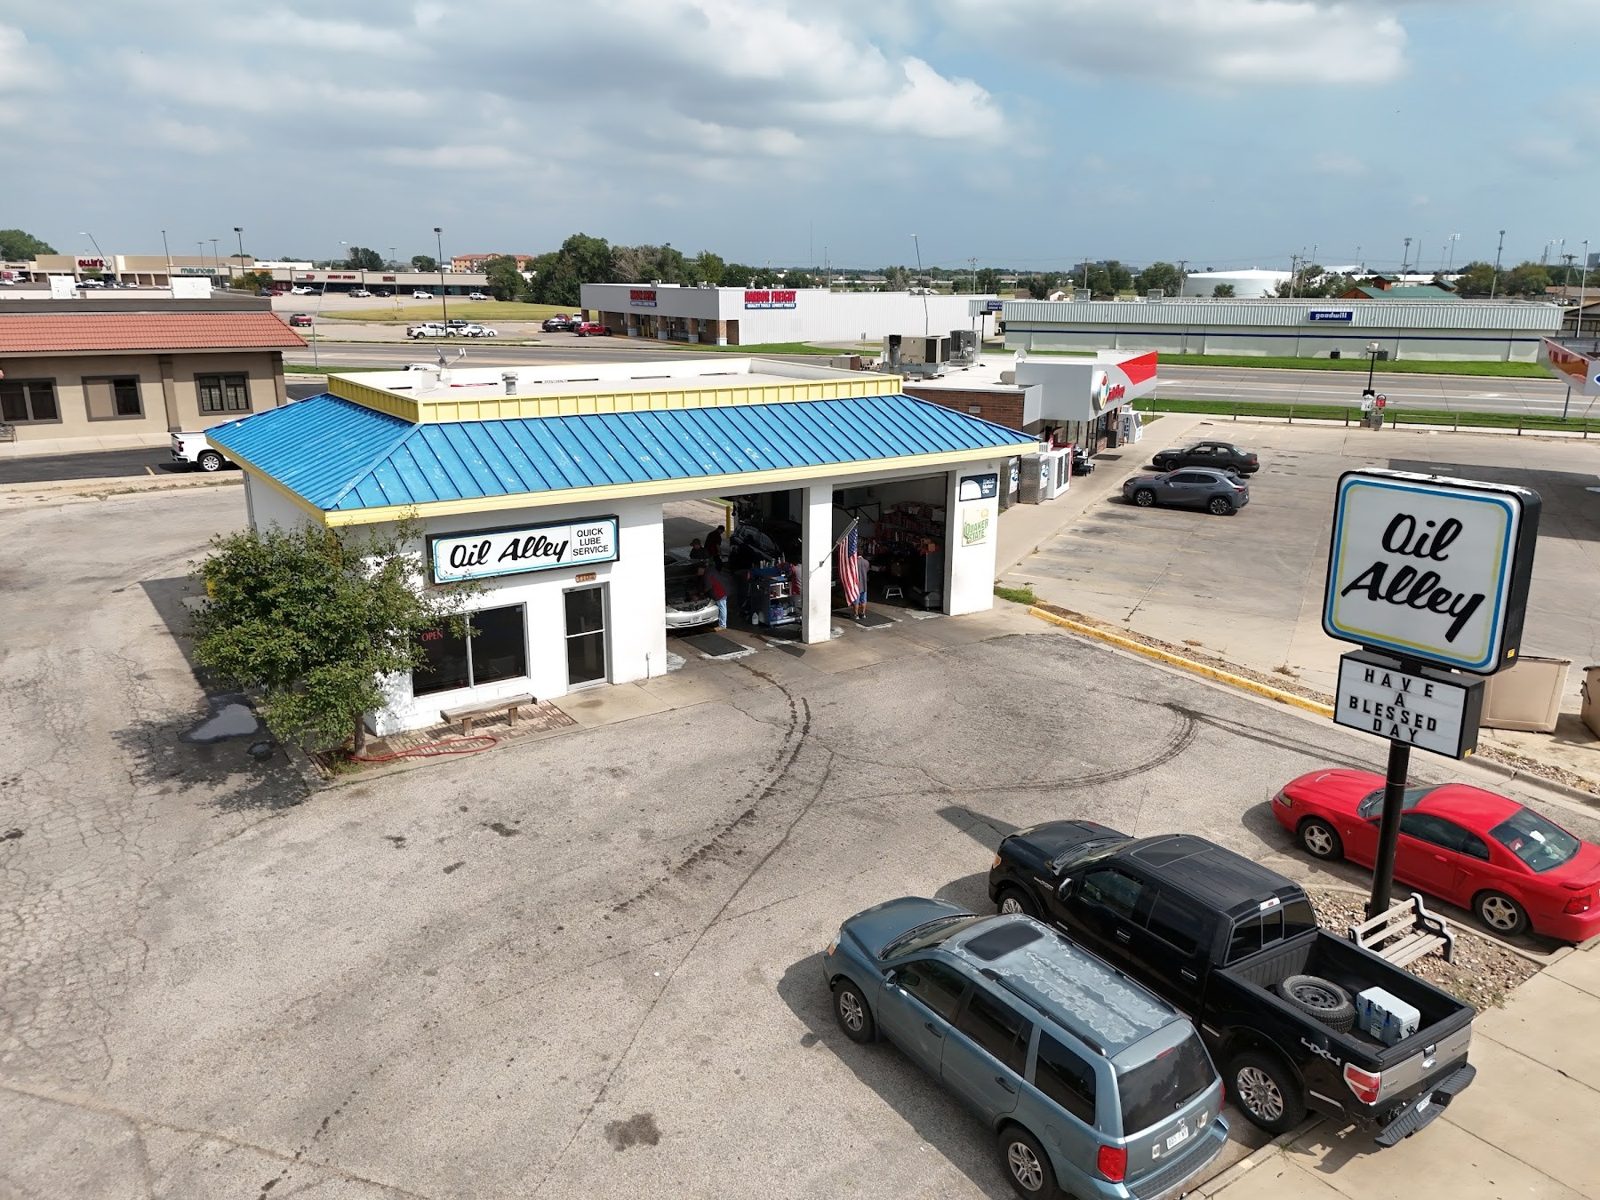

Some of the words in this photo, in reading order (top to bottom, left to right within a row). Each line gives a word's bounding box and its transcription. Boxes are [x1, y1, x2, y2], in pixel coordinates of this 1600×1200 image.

[771, 290, 796, 304] FREIGHT
[1315, 312, 1347, 320] goodwill
[577, 527, 603, 538] QUICK
[1382, 513, 1463, 561] Oil
[579, 537, 602, 546] LUBE
[450, 540, 492, 568] Oil
[498, 535, 569, 563] Alley
[572, 544, 609, 556] SERVICE
[1341, 561, 1485, 643] Alley
[421, 631, 443, 641] OPEN
[1364, 668, 1434, 698] HAVE
[1394, 692, 1405, 708] A
[1349, 695, 1437, 731] BLESSED
[1373, 718, 1418, 743] DAY
